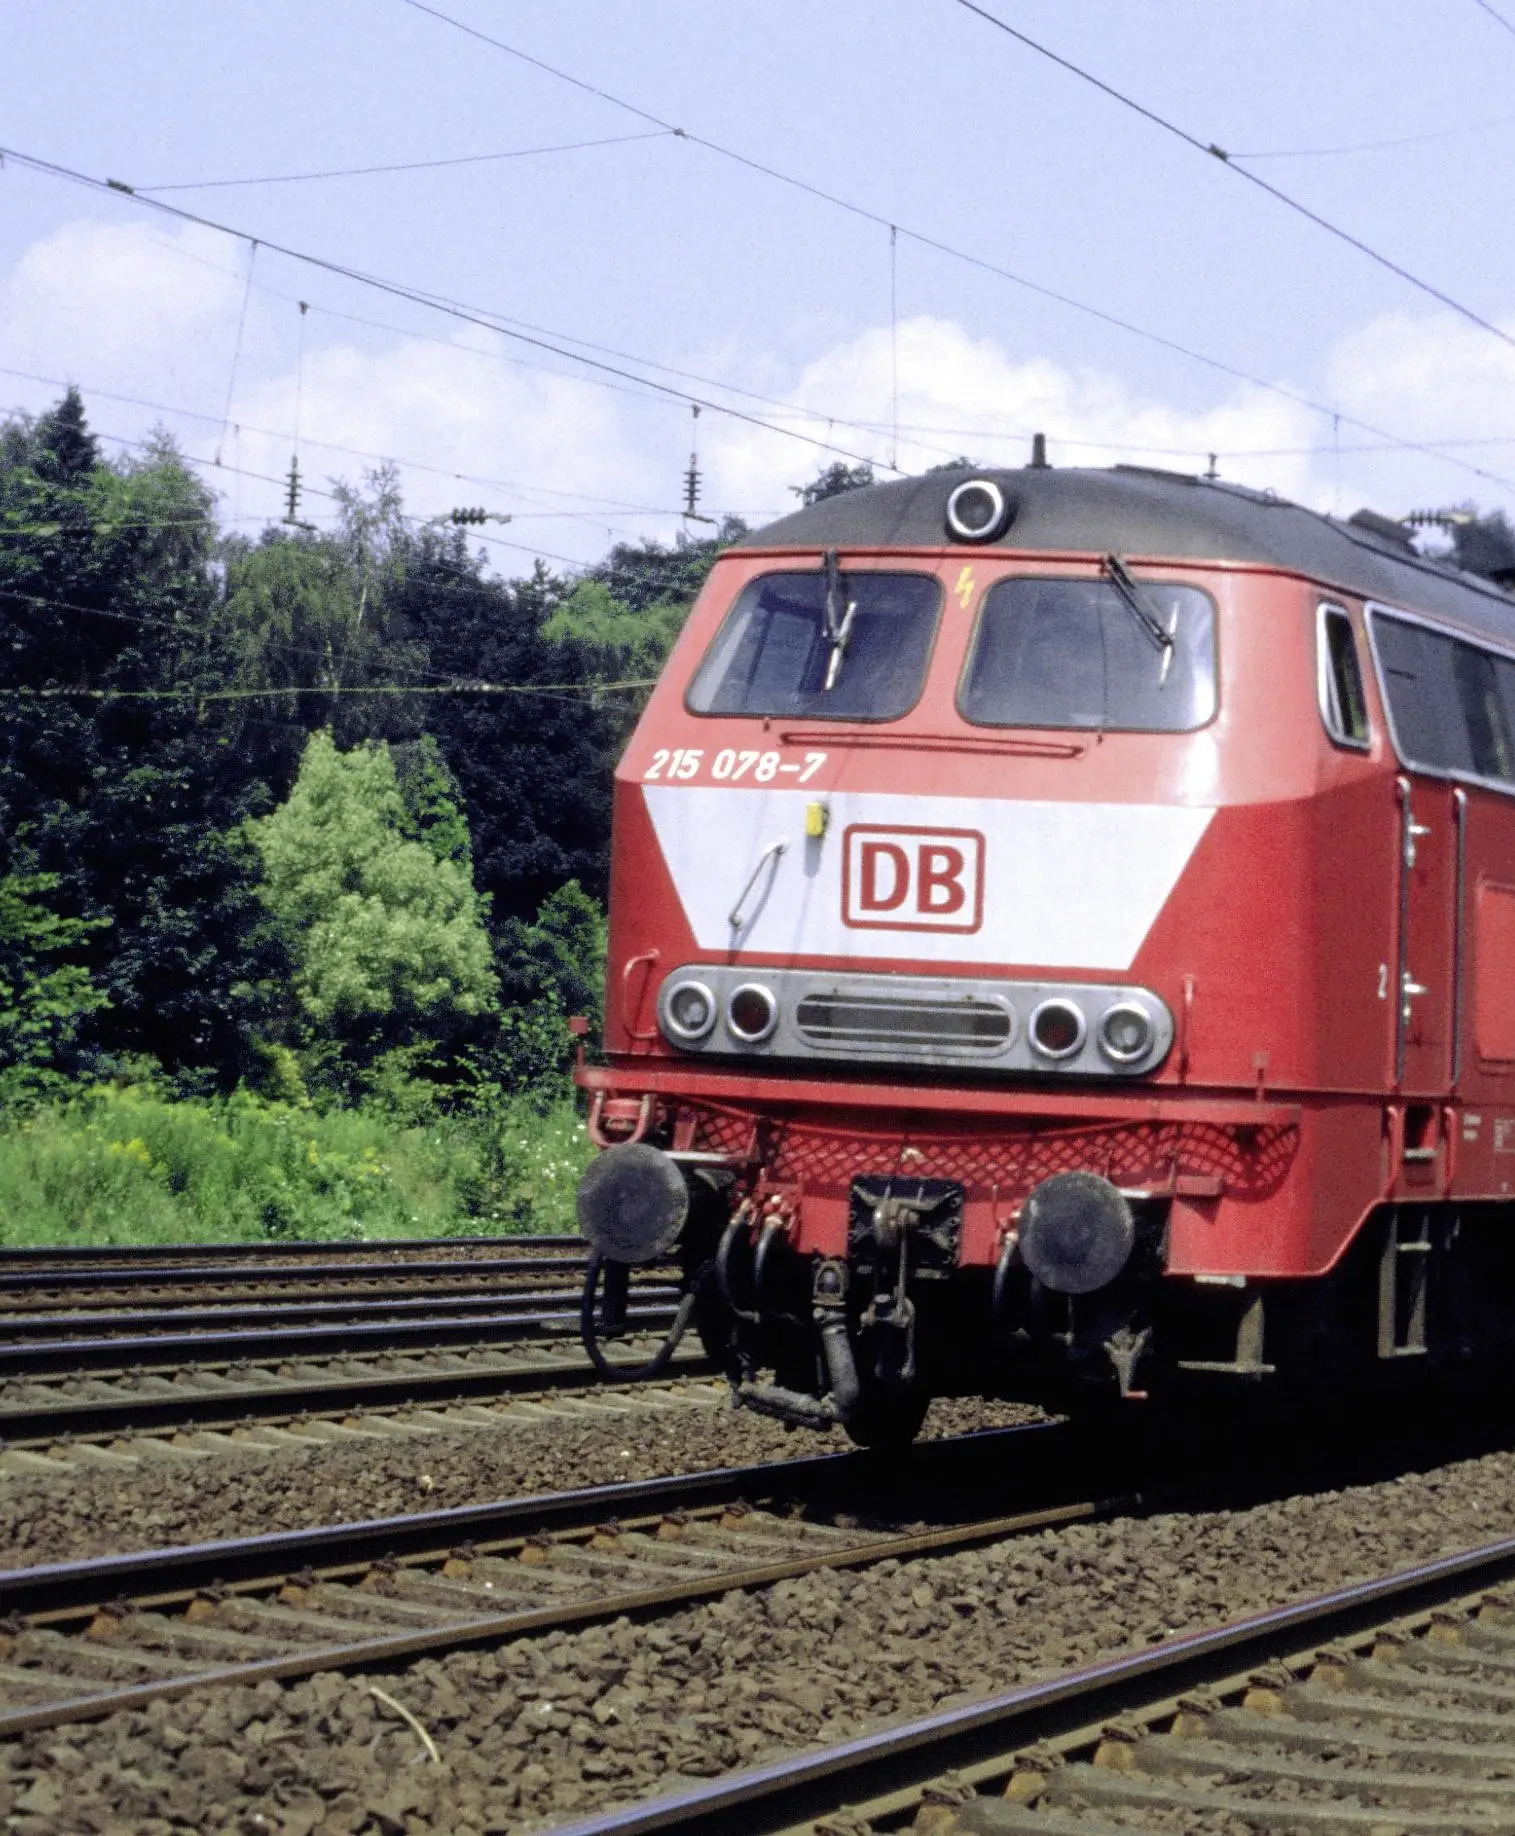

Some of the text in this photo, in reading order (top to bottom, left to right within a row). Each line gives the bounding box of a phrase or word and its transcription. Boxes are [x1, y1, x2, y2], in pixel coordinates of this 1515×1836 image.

[644, 748, 828, 783] 215 078-7
[859, 841, 966, 915] DB
